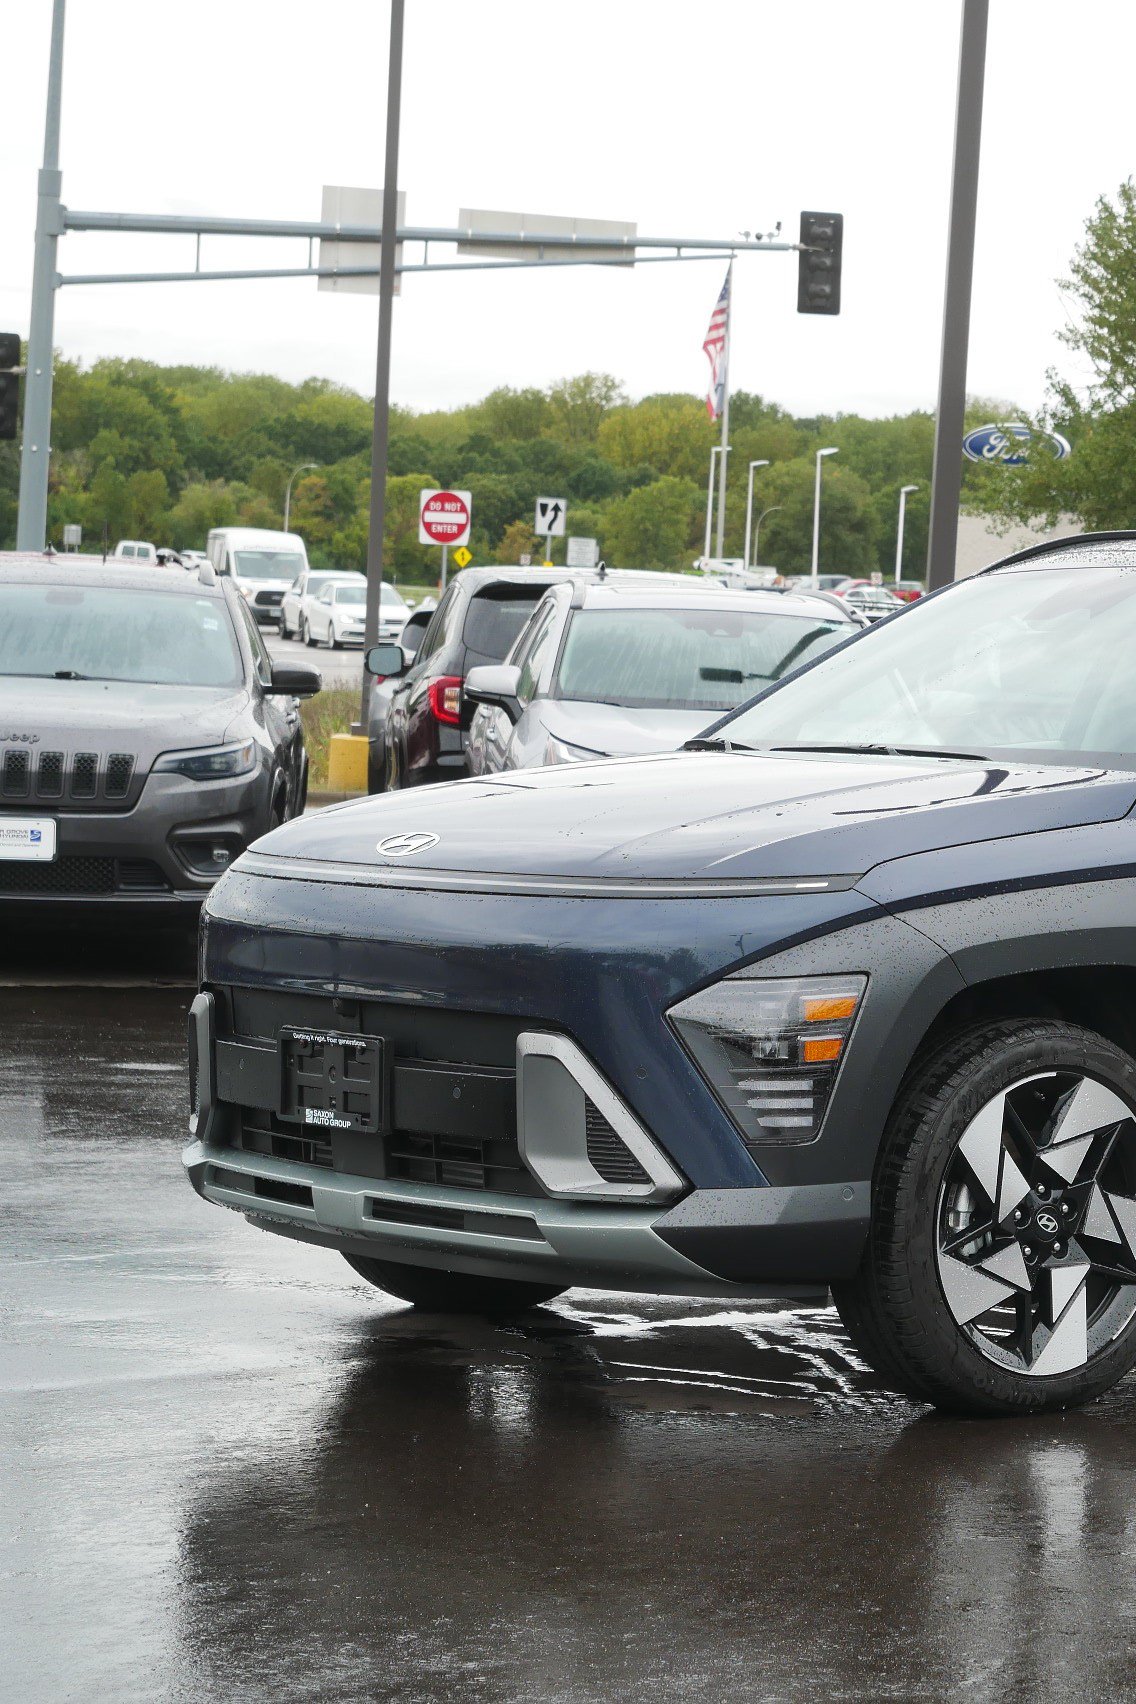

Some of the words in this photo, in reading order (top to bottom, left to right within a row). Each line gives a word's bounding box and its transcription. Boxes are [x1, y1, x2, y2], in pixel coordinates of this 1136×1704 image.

[429, 501, 442, 511] DO
[444, 502, 462, 512] NOT
[430, 523, 458, 534] ENTER
[313, 1109, 335, 1119] SAXON
[313, 1117, 330, 1126] AUTO
[329, 1119, 352, 1129] GROUP
